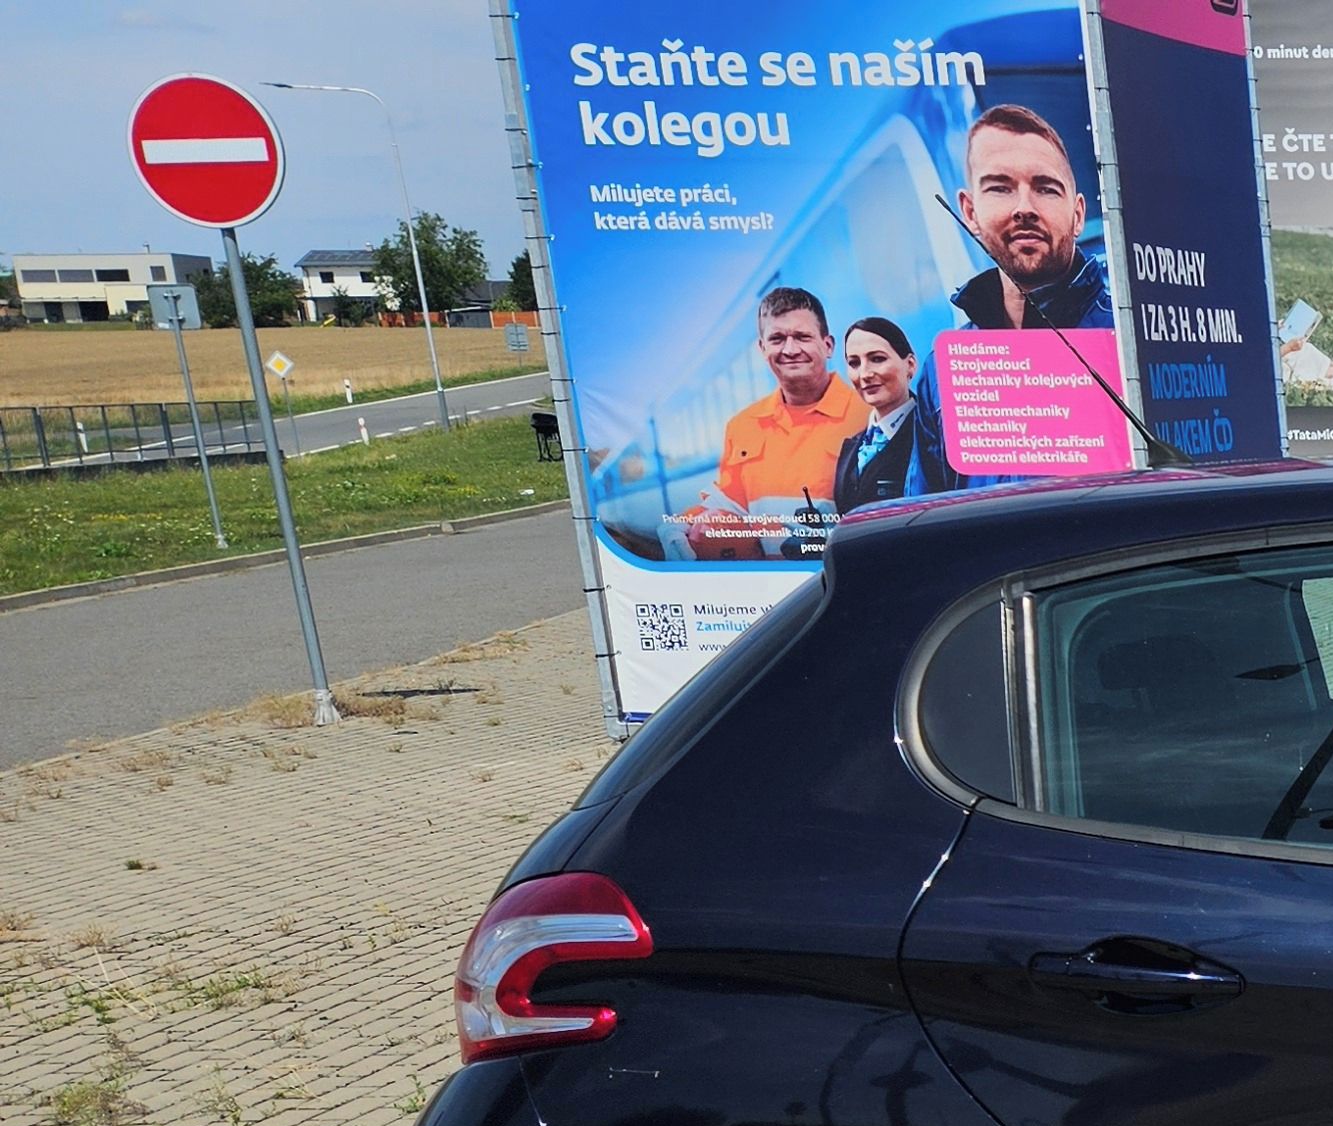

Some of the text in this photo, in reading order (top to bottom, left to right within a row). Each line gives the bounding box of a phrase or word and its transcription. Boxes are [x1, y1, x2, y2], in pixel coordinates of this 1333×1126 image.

[1253, 45, 1264, 58] 0
[1267, 44, 1309, 58] minut
[569, 37, 986, 88] Staňte se naším
[579, 100, 790, 157] kolegou
[1282, 128, 1326, 153] ČTE
[1282, 161, 1315, 181] TO
[590, 182, 738, 207] Milujete práci,
[594, 210, 774, 235] která dává smysl?
[1133, 242, 1206, 288] DO PRAHY
[1141, 304, 1243, 344] I ZA 3 H. 8 MIN.
[948, 344, 1010, 356] Hledáme:
[950, 359, 1030, 373] Strojvedoucí
[952, 374, 1093, 388] Mechaniky kolejových
[1149, 354, 1227, 399] MODERNÍM
[954, 390, 1000, 402] vozidel
[955, 405, 1070, 419] Elektromechaniky
[958, 421, 1027, 434] Mechaniky
[1213, 408, 1233, 451] ČD
[960, 436, 1105, 449] elektronických zařízení
[961, 451, 1088, 463] Provozní elektrikáře
[743, 512, 806, 526] strojvedoucí
[808, 514, 820, 523] 58
[705, 528, 792, 538] elektromechanik
[800, 543, 826, 554] prov
[694, 603, 757, 617] Milujeme
